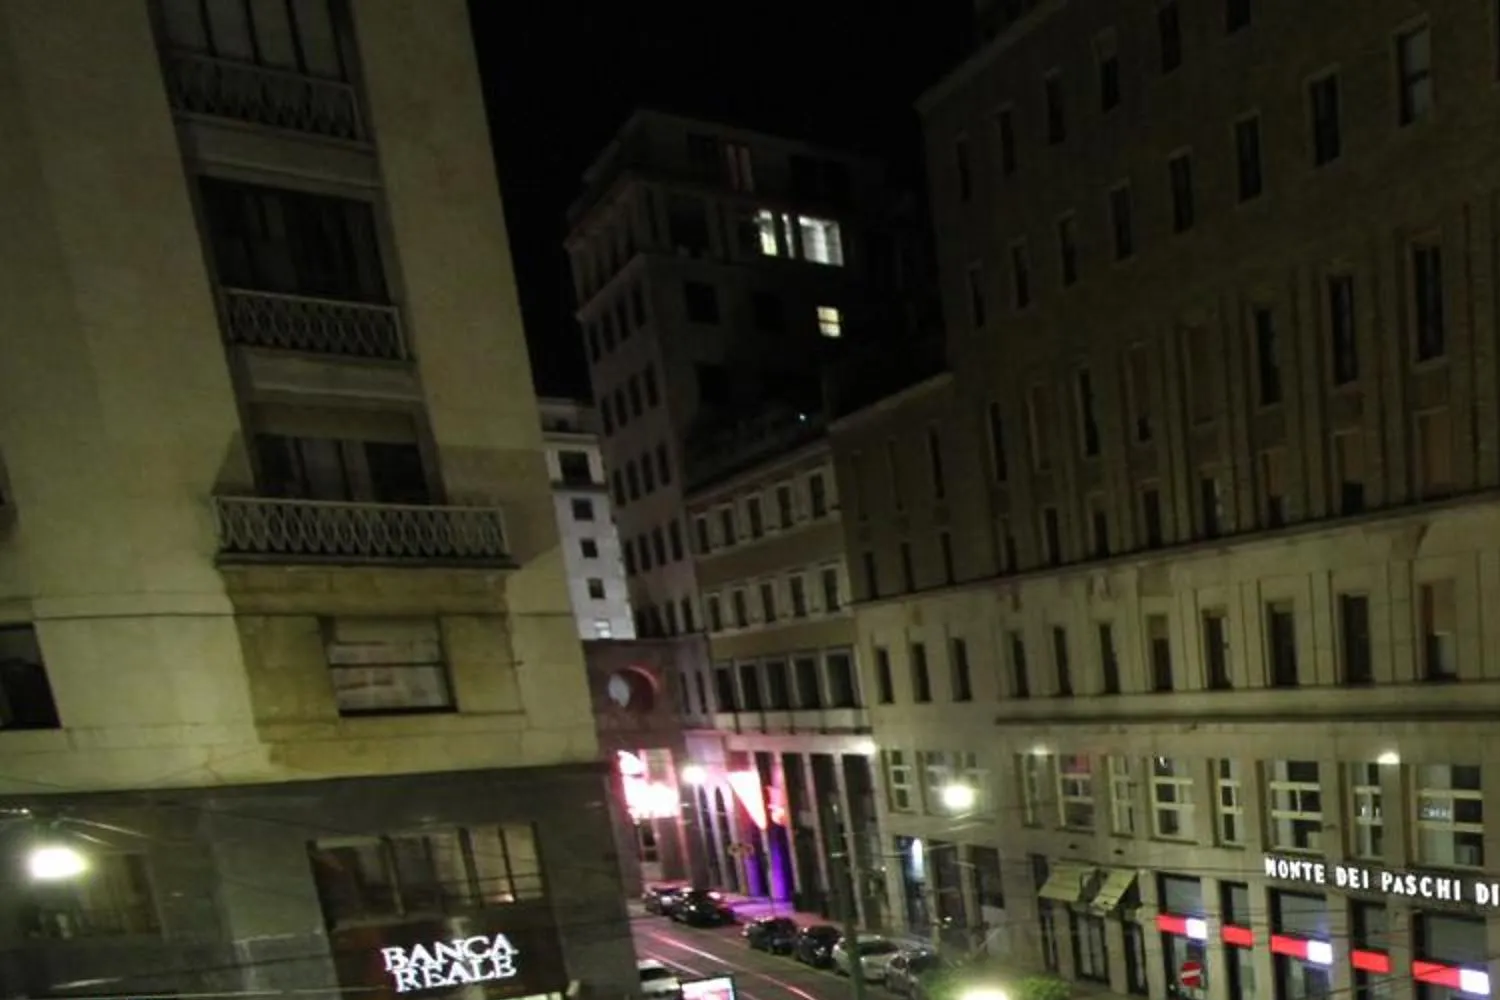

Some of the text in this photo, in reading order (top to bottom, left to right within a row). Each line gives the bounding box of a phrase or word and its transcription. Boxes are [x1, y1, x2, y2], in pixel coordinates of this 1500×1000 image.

[1264, 857, 1325, 884] MONTE
[1335, 865, 1369, 889] DEI
[1380, 871, 1461, 901] PASCHI
[1475, 882, 1499, 907] DI
[380, 932, 519, 971] BANCA
[393, 955, 517, 993] REALE
